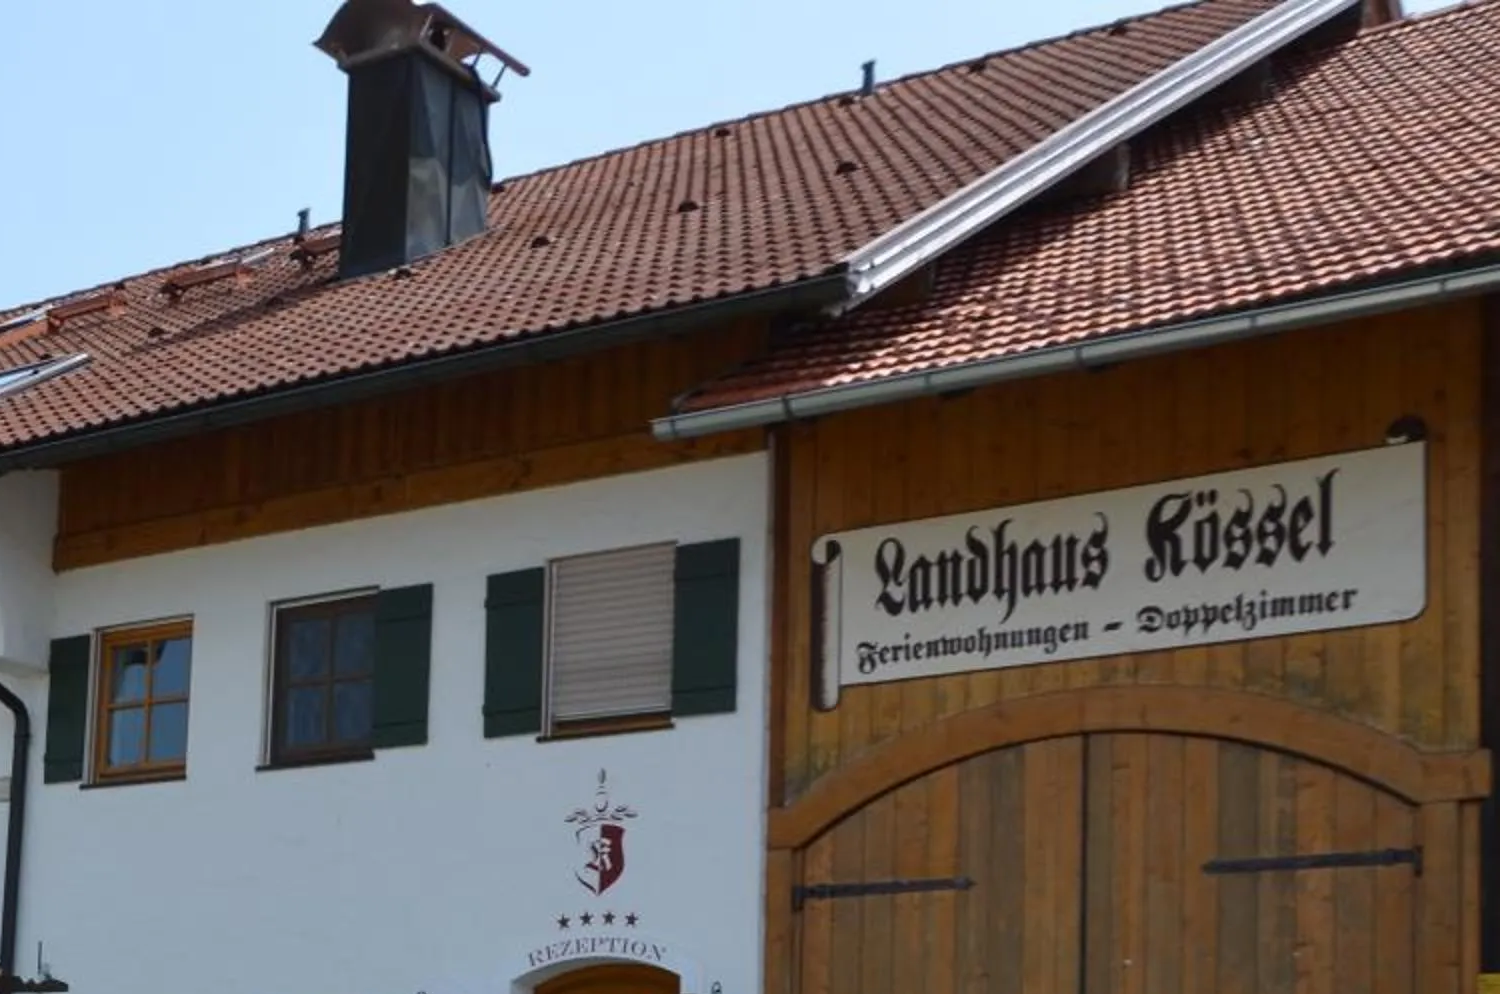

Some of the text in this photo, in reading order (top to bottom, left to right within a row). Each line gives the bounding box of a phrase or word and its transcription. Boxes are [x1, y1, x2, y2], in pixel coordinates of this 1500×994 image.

[875, 470, 1339, 624] Landhaus Kössel
[857, 622, 1090, 674] Ferienwohnungen
[1137, 589, 1358, 637] Doppelzimmer
[528, 936, 668, 966] REZEPTION
